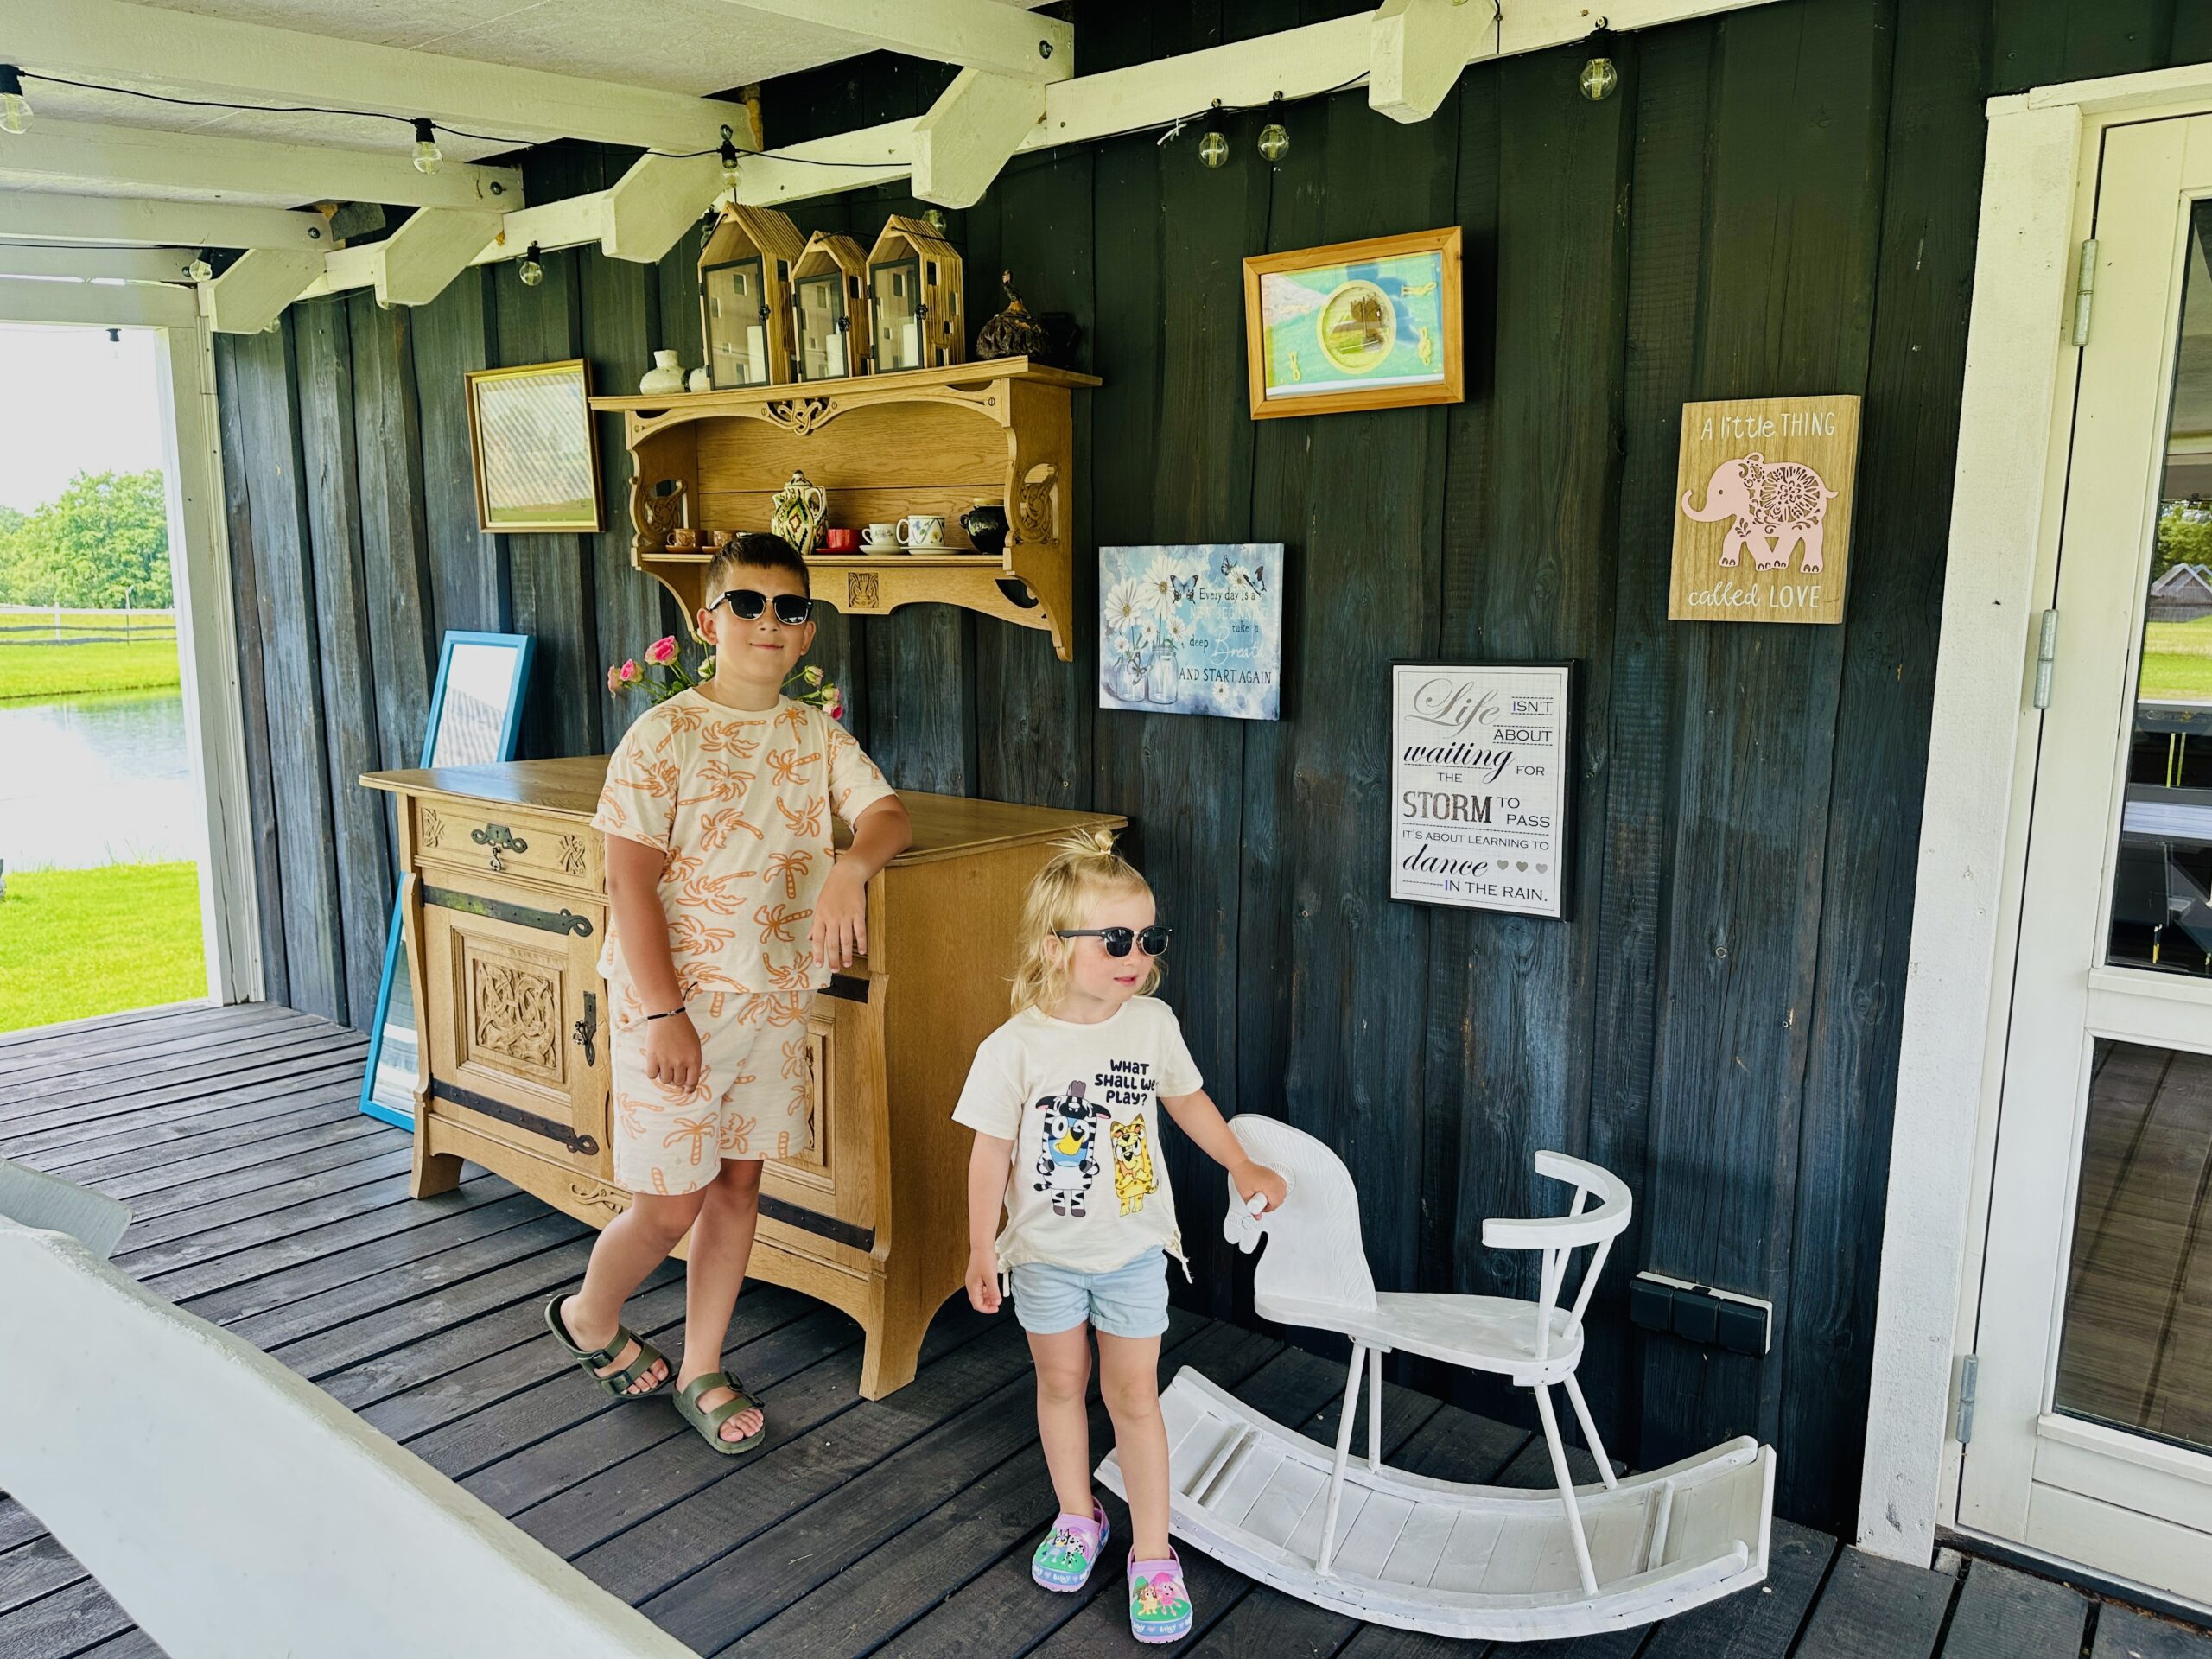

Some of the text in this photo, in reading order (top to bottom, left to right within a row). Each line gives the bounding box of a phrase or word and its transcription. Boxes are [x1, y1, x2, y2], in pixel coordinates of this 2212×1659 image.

[1700, 411, 1835, 440] A little THING
[1199, 588, 1223, 604] Every
[1224, 588, 1239, 603] day
[1241, 588, 1249, 601] is
[1688, 581, 1821, 608] called LOVE
[1232, 620, 1249, 632] take
[1189, 634, 1209, 653] deep
[1179, 668, 1271, 683] AND START AGAIN
[1404, 678, 1554, 739] Life ISN'T
[1493, 729, 1552, 741] ABOUT
[1403, 741, 1545, 785] waiting FOR
[1437, 772, 1463, 783] THE
[1402, 791, 1520, 823] STORM TO
[1506, 814, 1550, 828] PASS
[1402, 830, 1549, 850] IT'S ABOUT LEARNING TO
[1402, 843, 1489, 877] dance
[1445, 880, 1548, 902] IN THE RAIN.
